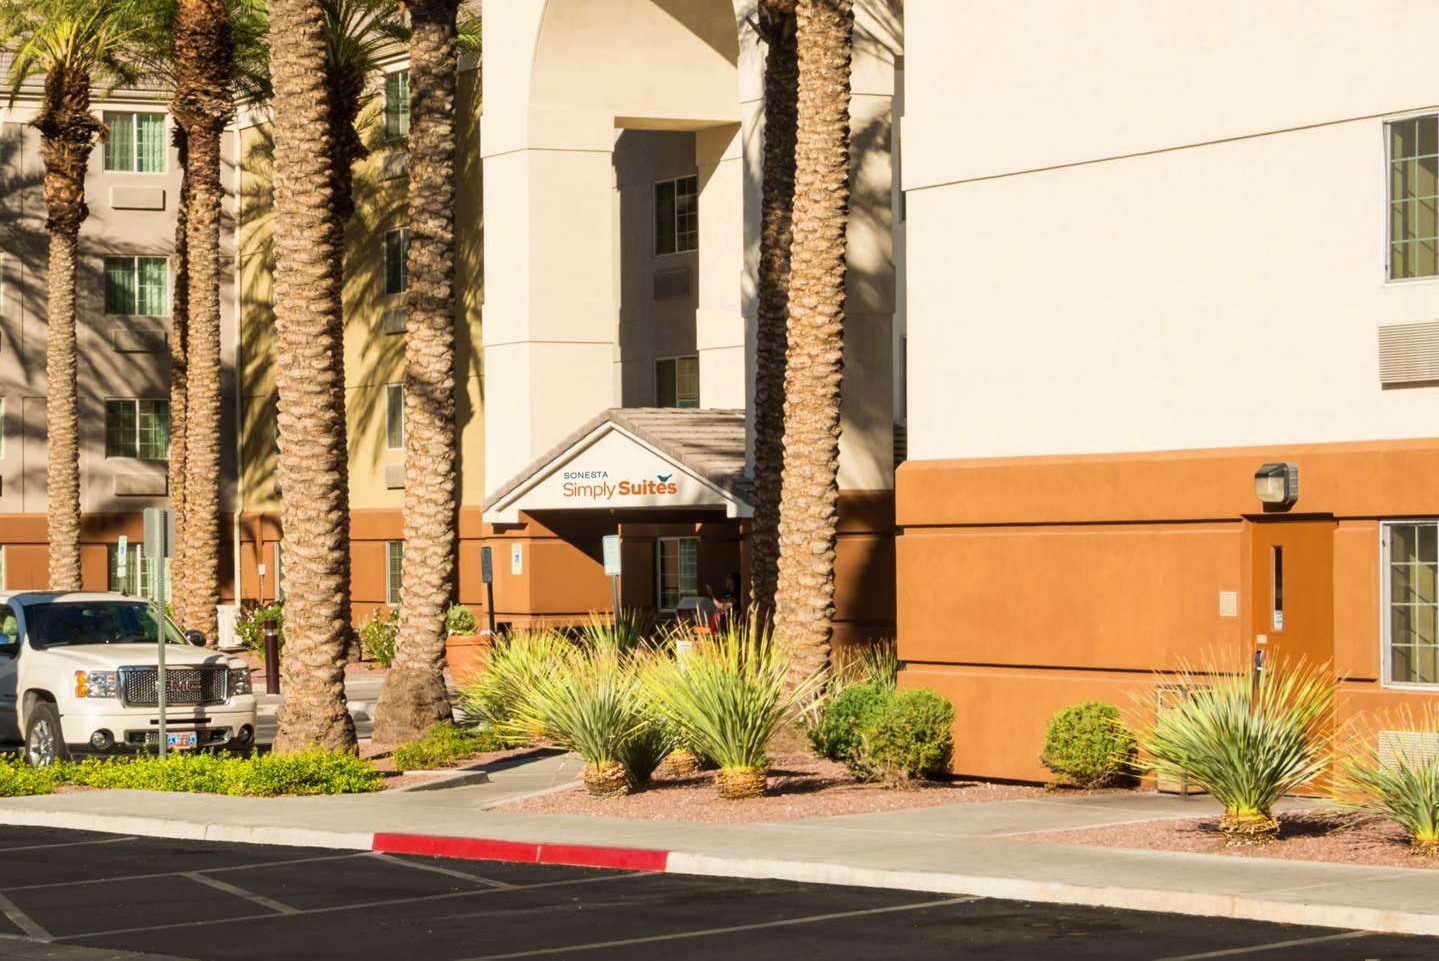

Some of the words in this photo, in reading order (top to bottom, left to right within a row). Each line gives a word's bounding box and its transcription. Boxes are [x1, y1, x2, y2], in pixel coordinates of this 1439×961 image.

[563, 471, 609, 480] SONESTA
[562, 481, 617, 500] Simply
[618, 479, 678, 496] Suites
